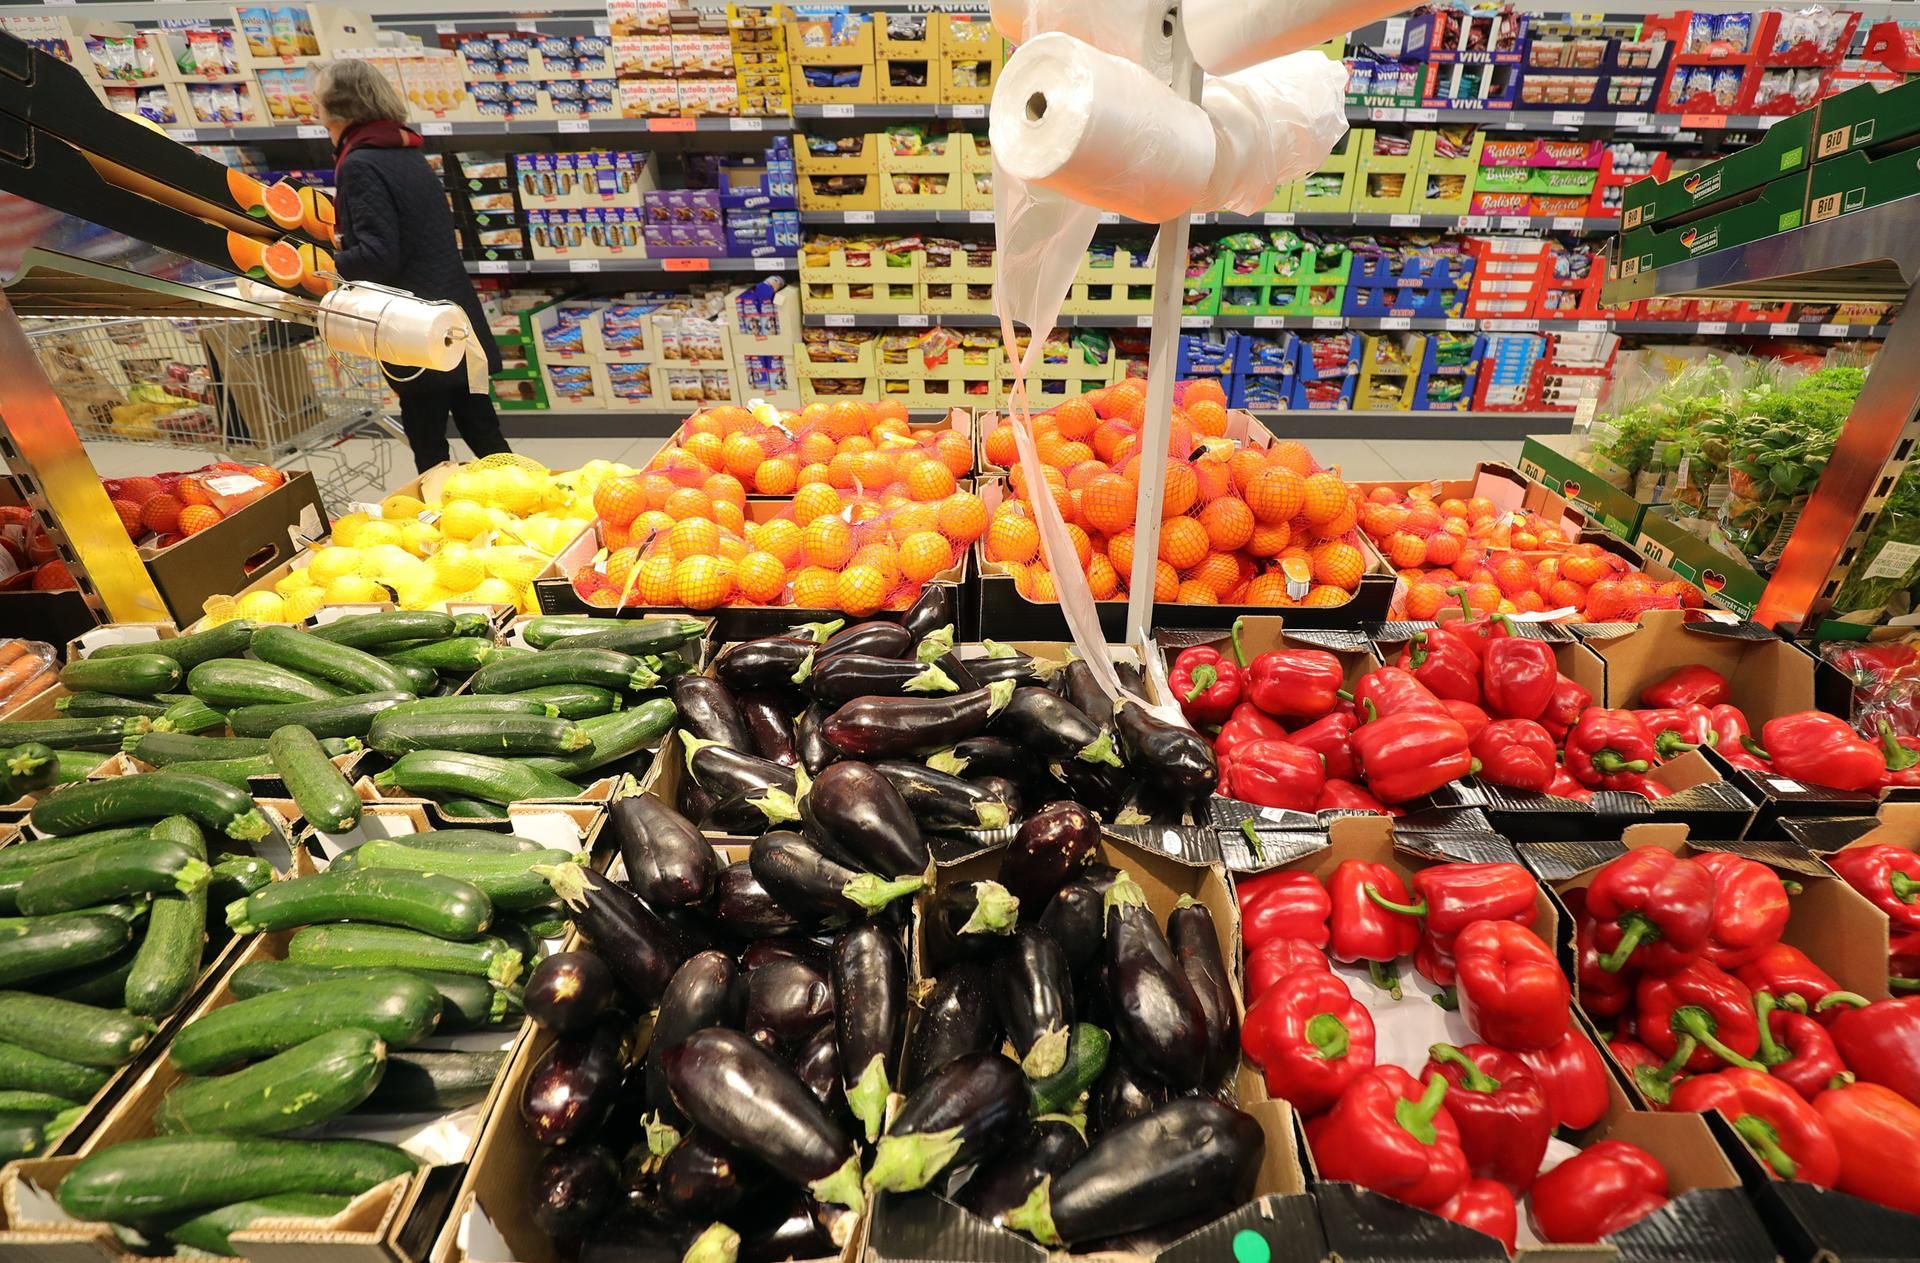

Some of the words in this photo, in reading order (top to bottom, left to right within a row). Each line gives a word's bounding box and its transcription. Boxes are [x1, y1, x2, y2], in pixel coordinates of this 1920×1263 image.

[1460, 52, 1492, 63] VIVIL
[1364, 96, 1396, 107] VIVIL
[1452, 99, 1484, 110] VIVIL
[1487, 143, 1527, 158] Balisto
[1545, 144, 1584, 158] Balisto
[1486, 167, 1527, 181] Balisto
[1549, 174, 1588, 187] Balisto
[1481, 194, 1522, 209] Balisto
[1539, 198, 1580, 211] Balisto
[1817, 197, 1834, 214] BiO
